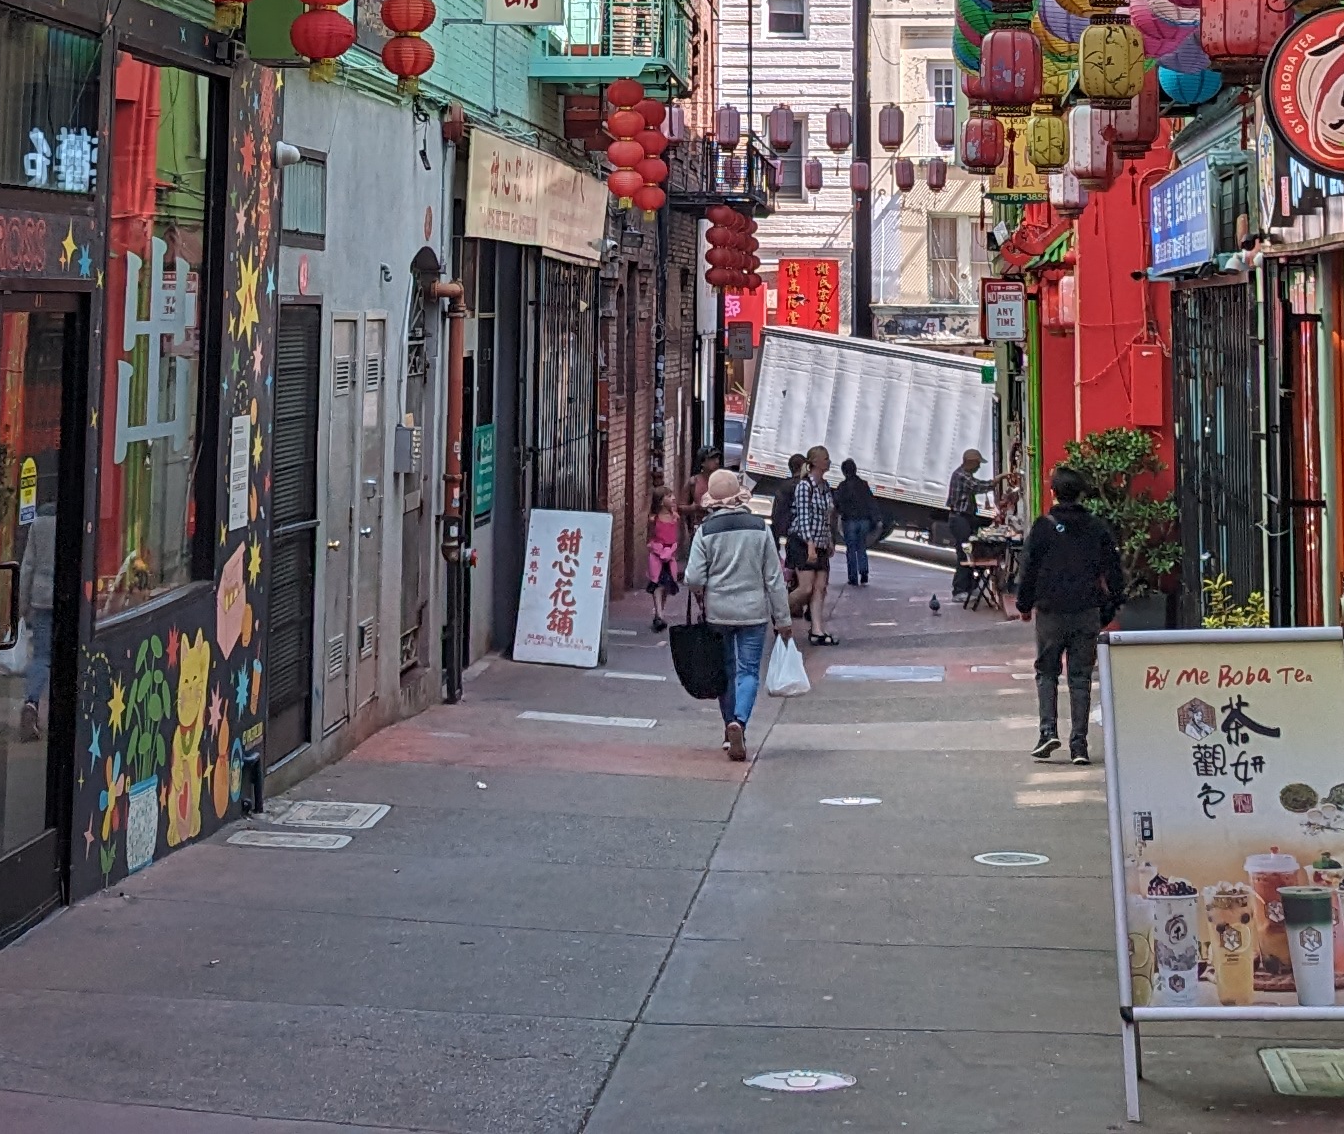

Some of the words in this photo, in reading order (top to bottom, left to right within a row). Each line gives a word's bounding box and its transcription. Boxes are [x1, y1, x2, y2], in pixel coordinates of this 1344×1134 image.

[1293, 32, 1316, 54] TEA
[1281, 55, 1299, 91] BOBA
[1281, 95, 1295, 115] ME
[1289, 117, 1305, 134] BY
[996, 307, 1014, 317] ANY
[996, 317, 1016, 327] TIME
[1145, 666, 1171, 691] By
[1175, 667, 1211, 686] Me
[1217, 664, 1272, 689] Boba
[1276, 666, 1313, 686] Tea
